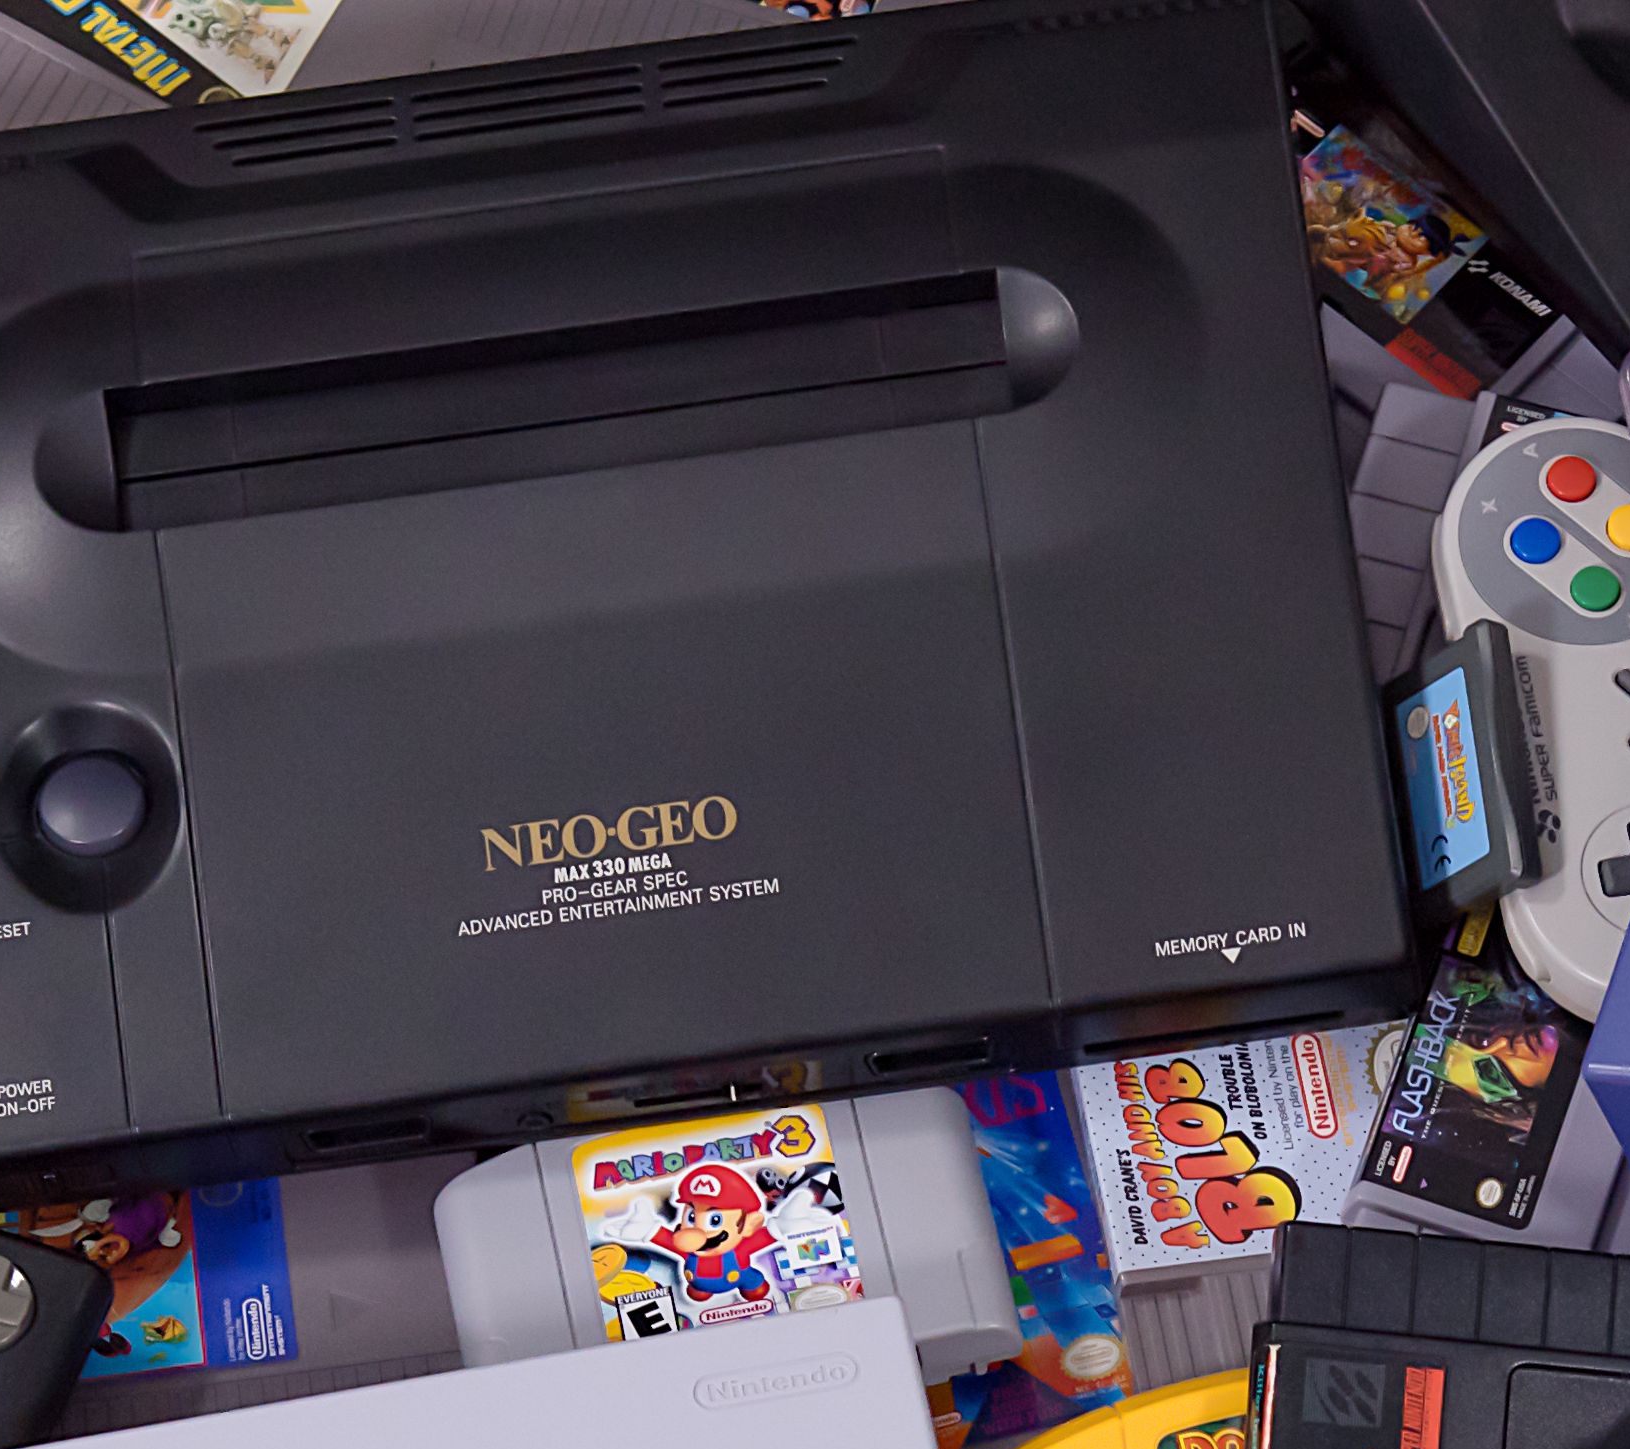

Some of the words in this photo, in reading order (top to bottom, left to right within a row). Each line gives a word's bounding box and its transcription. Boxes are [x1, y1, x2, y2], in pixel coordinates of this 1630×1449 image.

[77, 2, 190, 96] METAL
[1488, 271, 1552, 317] KONAMI
[555, 863, 590, 882] MAX
[594, 858, 625, 878] 330
[629, 853, 672, 871] MEGA
[458, 912, 554, 937] ADVANCED
[559, 888, 702, 924] ENTERTAINMENT
[709, 879, 780, 901] SYSTEM
[1154, 934, 1229, 957] MEMORY
[1235, 929, 1281, 946] CARD
[1288, 922, 1306, 939] IN
[1115, 1060, 1145, 1102] HIS
[1218, 1053, 1233, 1110] TROUBLE
[1298, 1040, 1331, 1129] Nintendo
[1394, 990, 1457, 1137] FLASHBACK
[1123, 1106, 1165, 1160] AND
[1278, 1095, 1293, 1150] Licensed
[592, 1152, 683, 1190] MARIO
[683, 1132, 773, 1171] PARTY
[772, 1115, 817, 1158] 3
[1121, 1148, 1139, 1201] CRANE'S
[1144, 1058, 1303, 1243] BLOB
[1375, 1141, 1392, 1177] LICENSED
[1138, 1162, 1190, 1221] BOY
[1133, 1204, 1148, 1245] DAVID
[1160, 1221, 1210, 1248] A
[616, 1287, 671, 1306] EVERYONE
[704, 1302, 768, 1322] Nintendo
